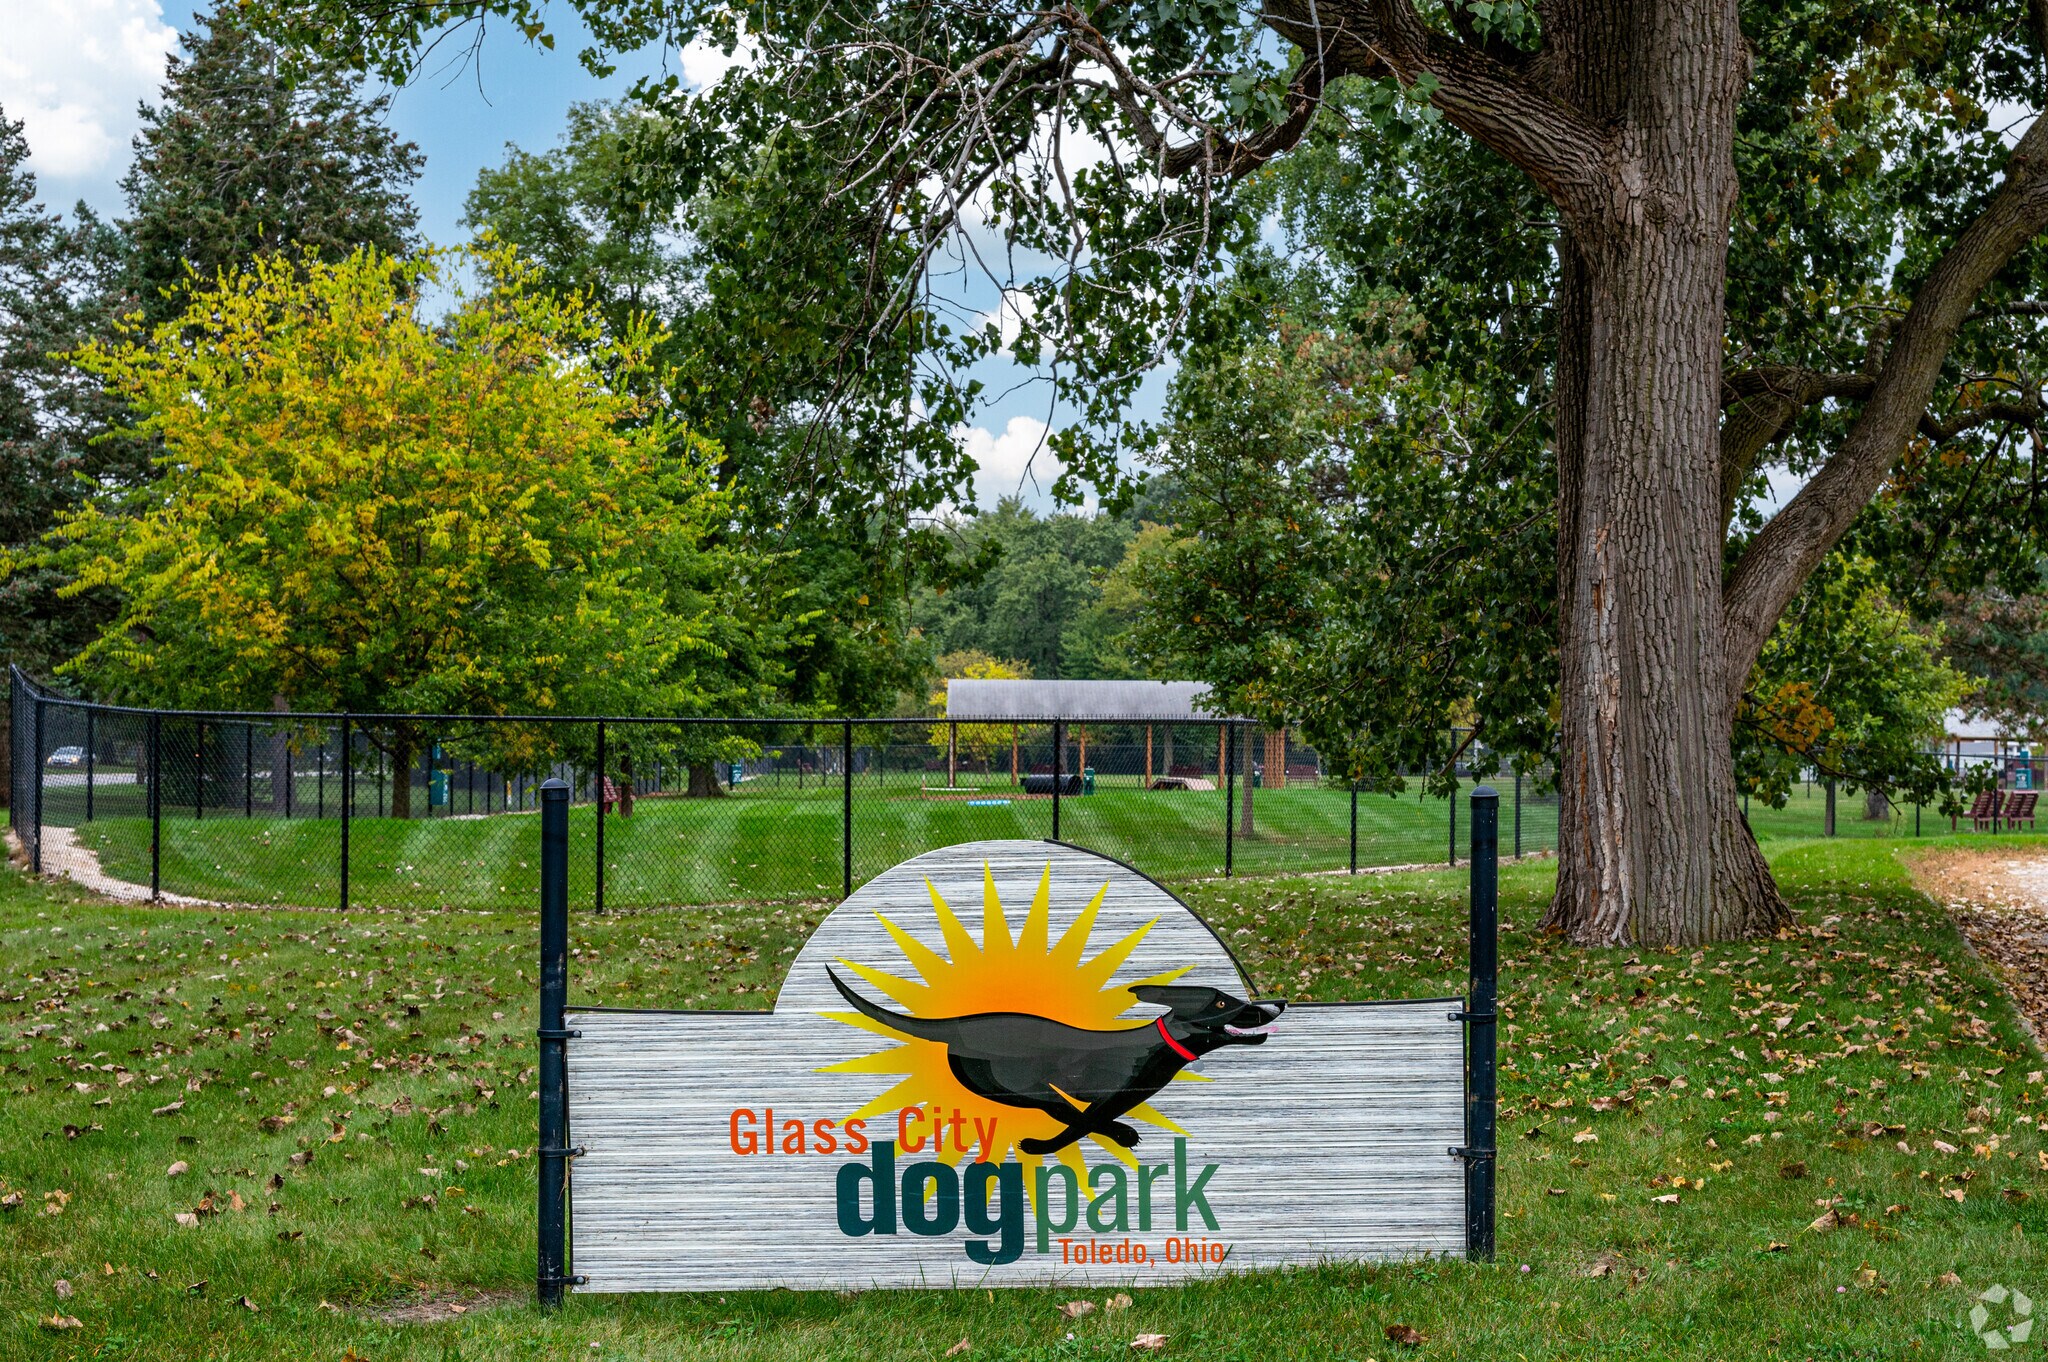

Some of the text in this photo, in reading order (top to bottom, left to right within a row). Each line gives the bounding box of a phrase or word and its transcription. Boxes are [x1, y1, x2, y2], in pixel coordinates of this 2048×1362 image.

[729, 1105, 998, 1164] Glass City
[1057, 1236, 1224, 1268] Toledo, Ohio
